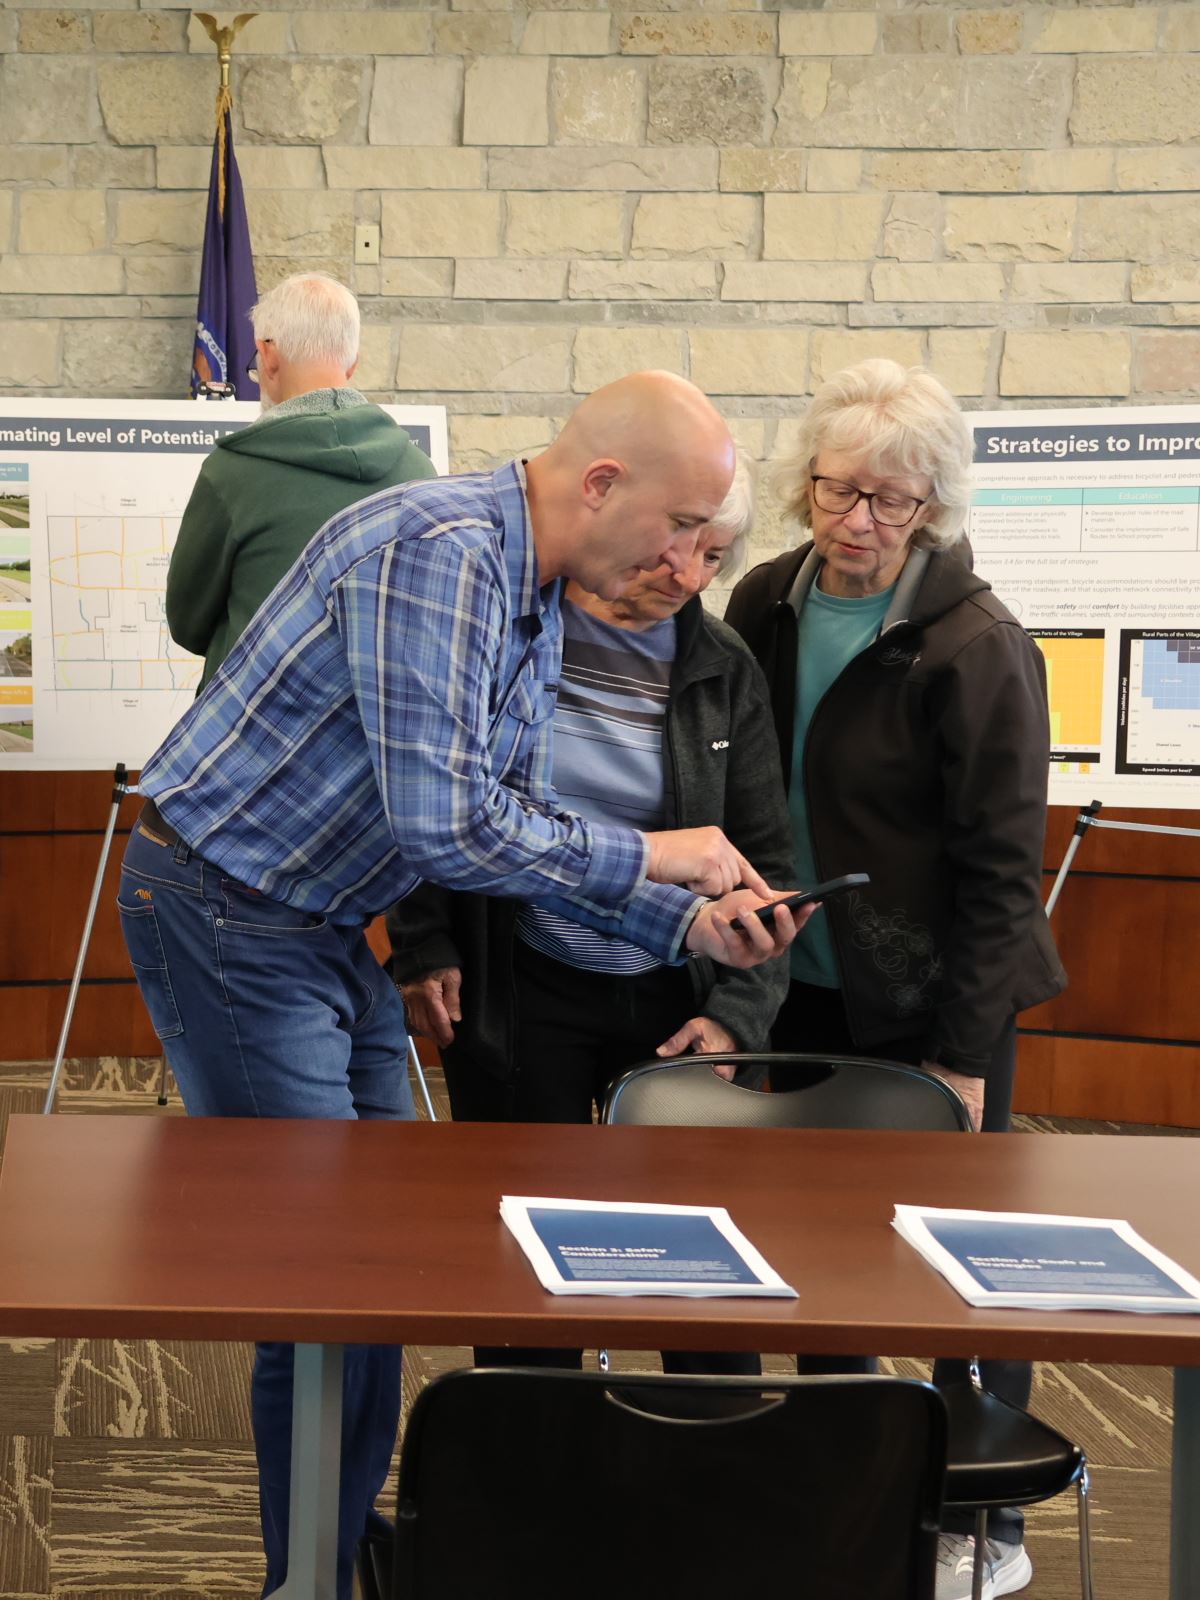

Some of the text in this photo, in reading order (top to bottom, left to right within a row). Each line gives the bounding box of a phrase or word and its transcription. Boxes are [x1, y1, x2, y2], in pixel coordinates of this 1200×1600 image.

[66, 427, 112, 443] Level
[116, 428, 136, 444] of
[141, 429, 219, 445] Potential
[987, 435, 1099, 457] Strategies
[1107, 436, 1131, 452] to
[1027, 473, 1058, 482] approach
[1066, 474, 1097, 482] necessary
[1001, 493, 1053, 504] Engineering
[1119, 491, 1163, 501] Education
[1056, 602, 1077, 612] safety
[1092, 602, 1120, 610] comfort
